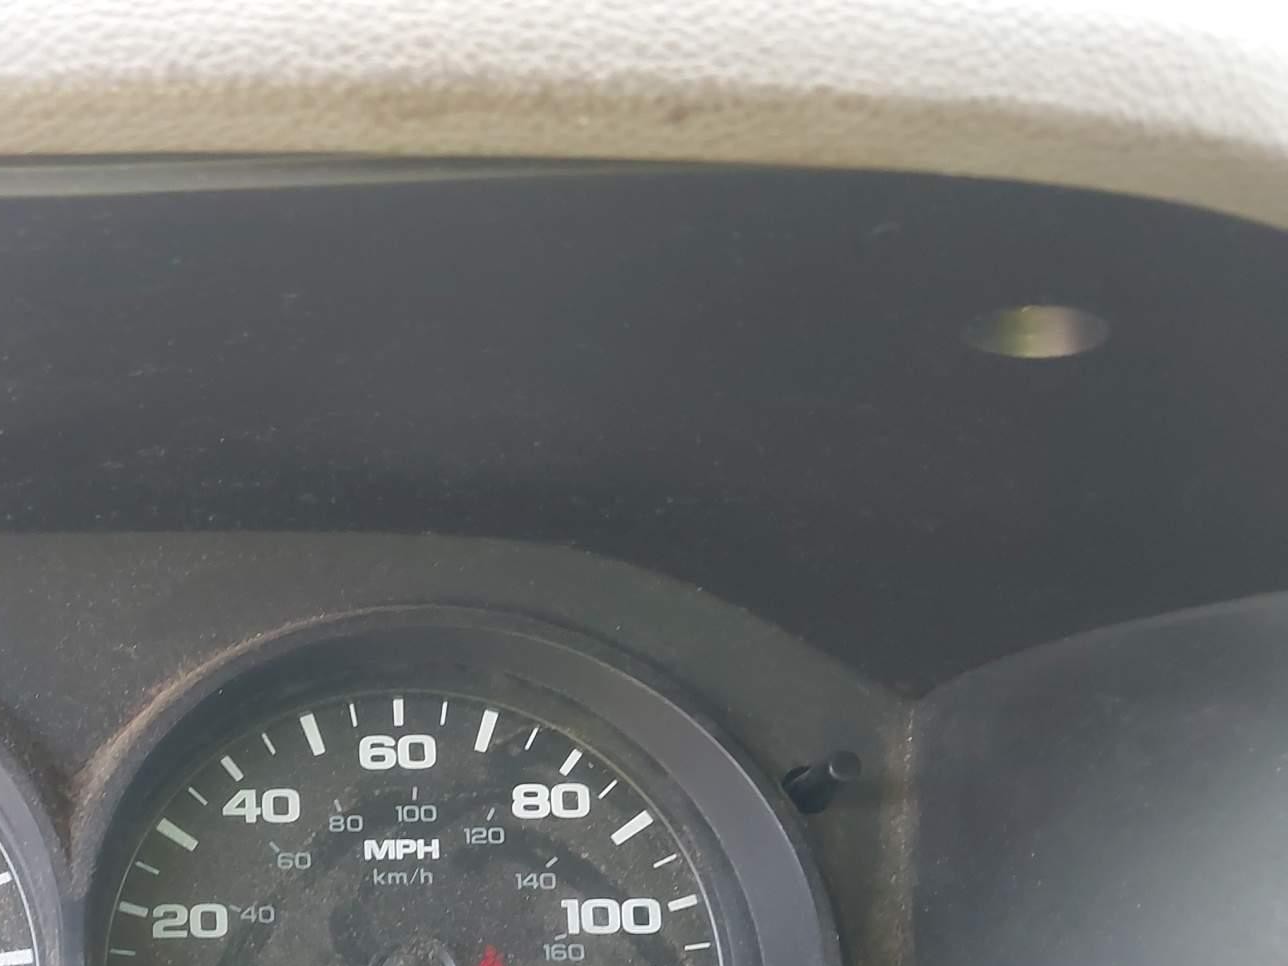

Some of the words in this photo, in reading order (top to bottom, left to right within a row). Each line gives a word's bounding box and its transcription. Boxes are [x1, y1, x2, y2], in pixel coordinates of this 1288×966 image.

[358, 734, 437, 769] 60
[222, 788, 300, 823] 40
[512, 782, 590, 818] 80
[395, 804, 437, 823] 100
[328, 814, 363, 833] 80
[463, 826, 505, 845] 120
[363, 838, 440, 861] MPH
[276, 851, 312, 870] 60
[373, 866, 434, 885] km/h
[515, 871, 557, 890] 140
[152, 902, 228, 938] 20
[240, 904, 275, 923] 40
[560, 898, 662, 935] 100
[543, 942, 585, 962] 160
